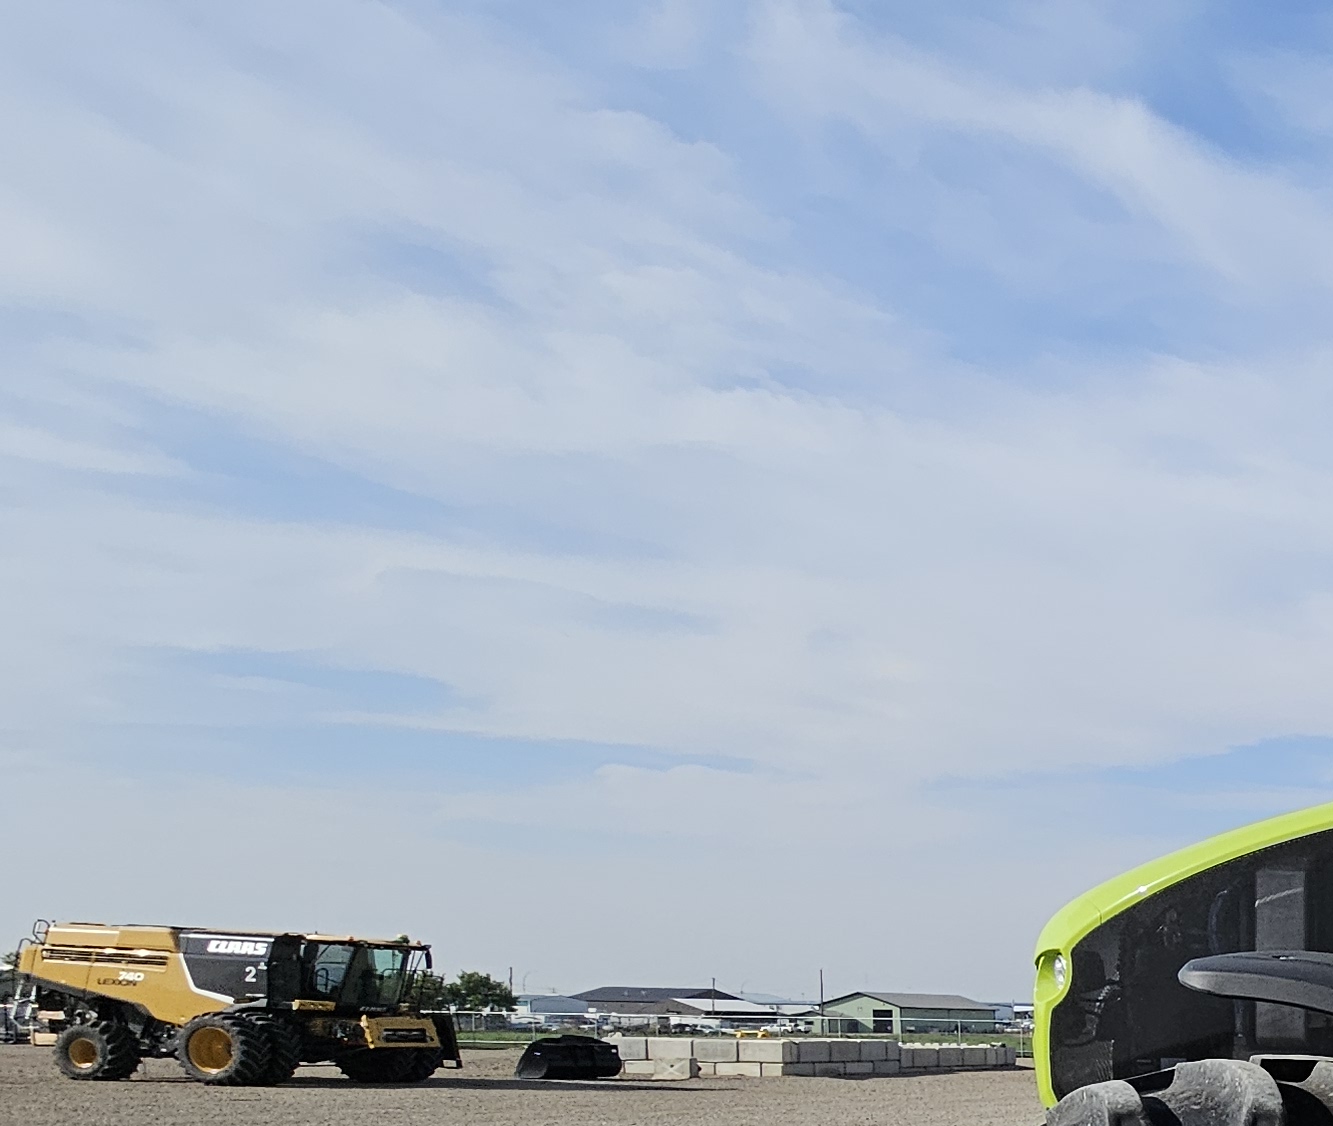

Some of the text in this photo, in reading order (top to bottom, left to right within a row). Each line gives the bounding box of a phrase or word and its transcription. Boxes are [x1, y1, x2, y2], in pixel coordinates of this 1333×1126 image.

[207, 940, 268, 956] CLAAS
[118, 971, 145, 982] 740
[245, 966, 257, 982] 2
